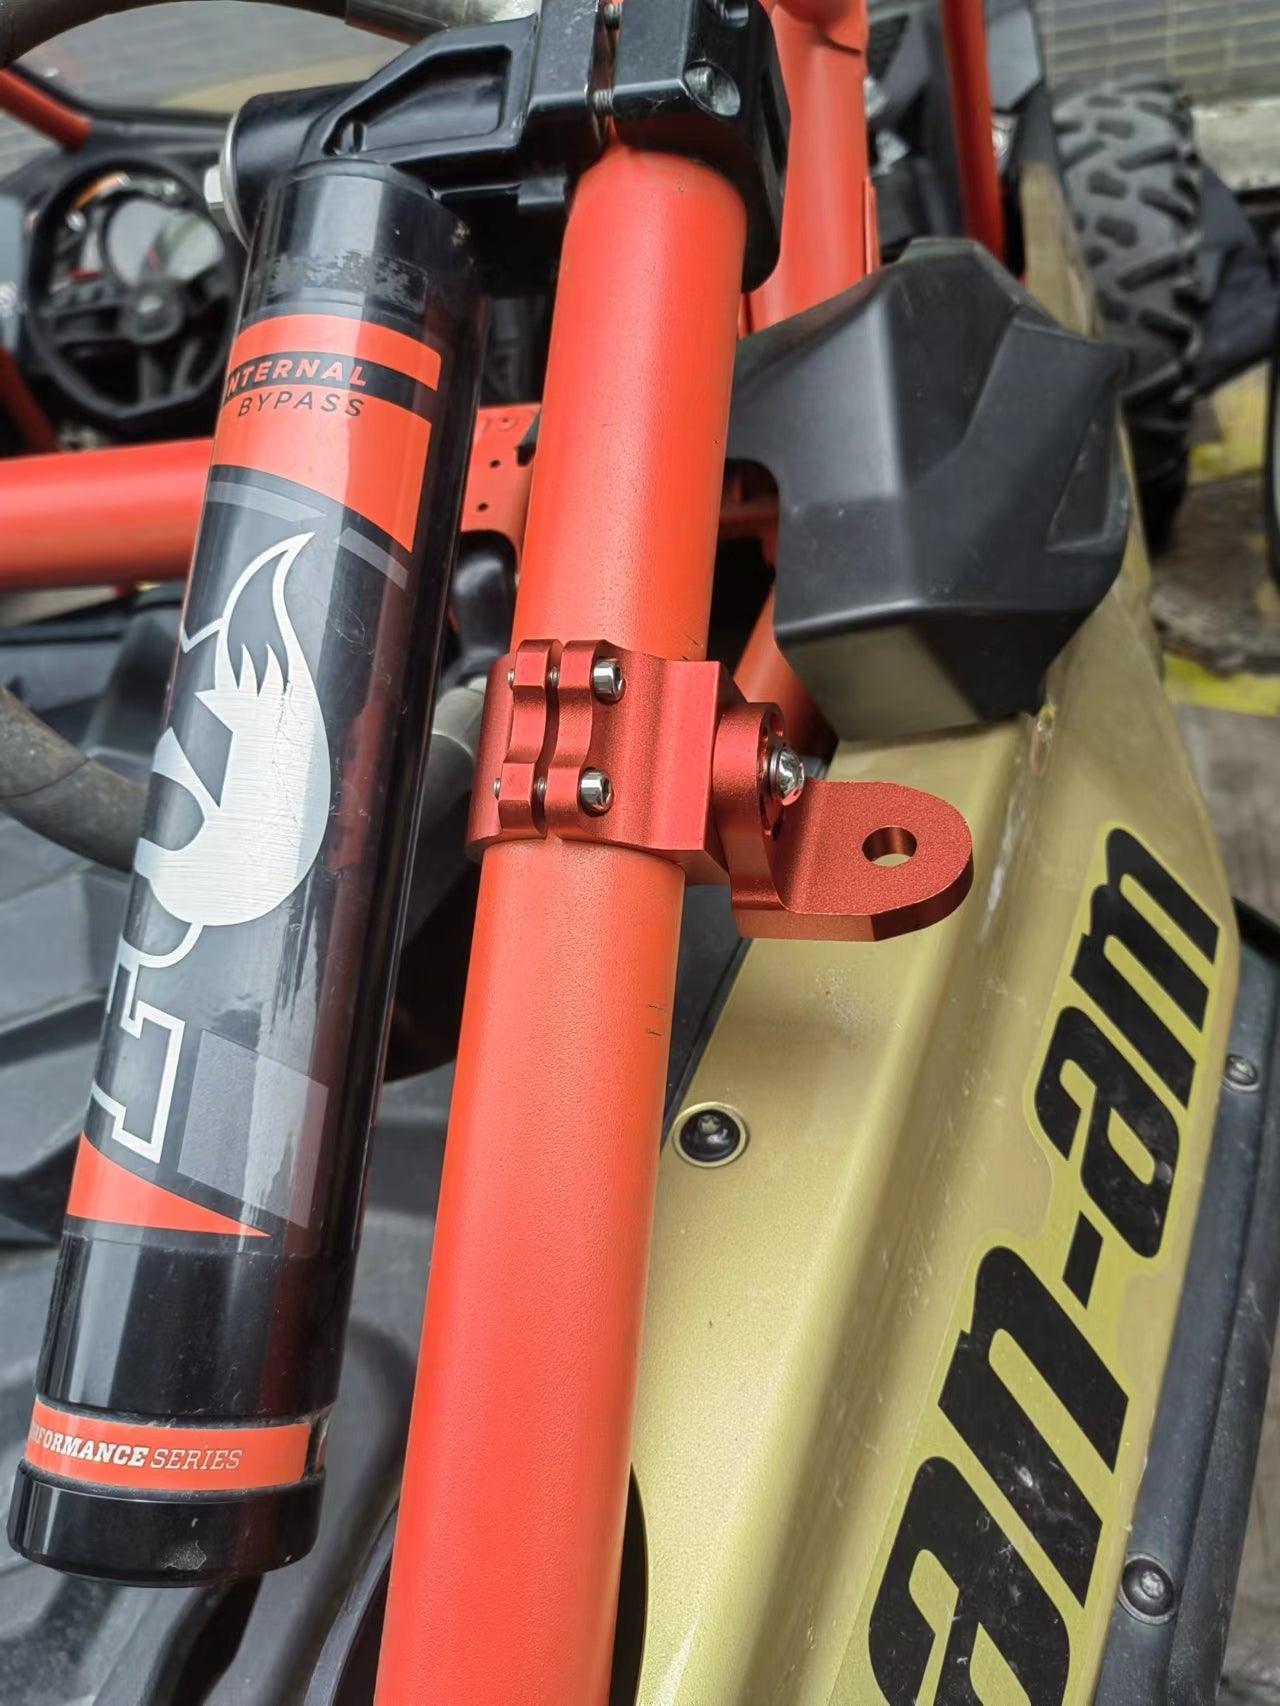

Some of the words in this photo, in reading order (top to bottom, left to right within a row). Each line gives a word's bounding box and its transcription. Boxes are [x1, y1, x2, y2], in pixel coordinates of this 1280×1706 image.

[227, 359, 367, 397] NTERNAL
[238, 391, 364, 417] BYPASS
[868, 827, 1220, 1706] an-am
[151, 1449, 242, 1470] SERIES
